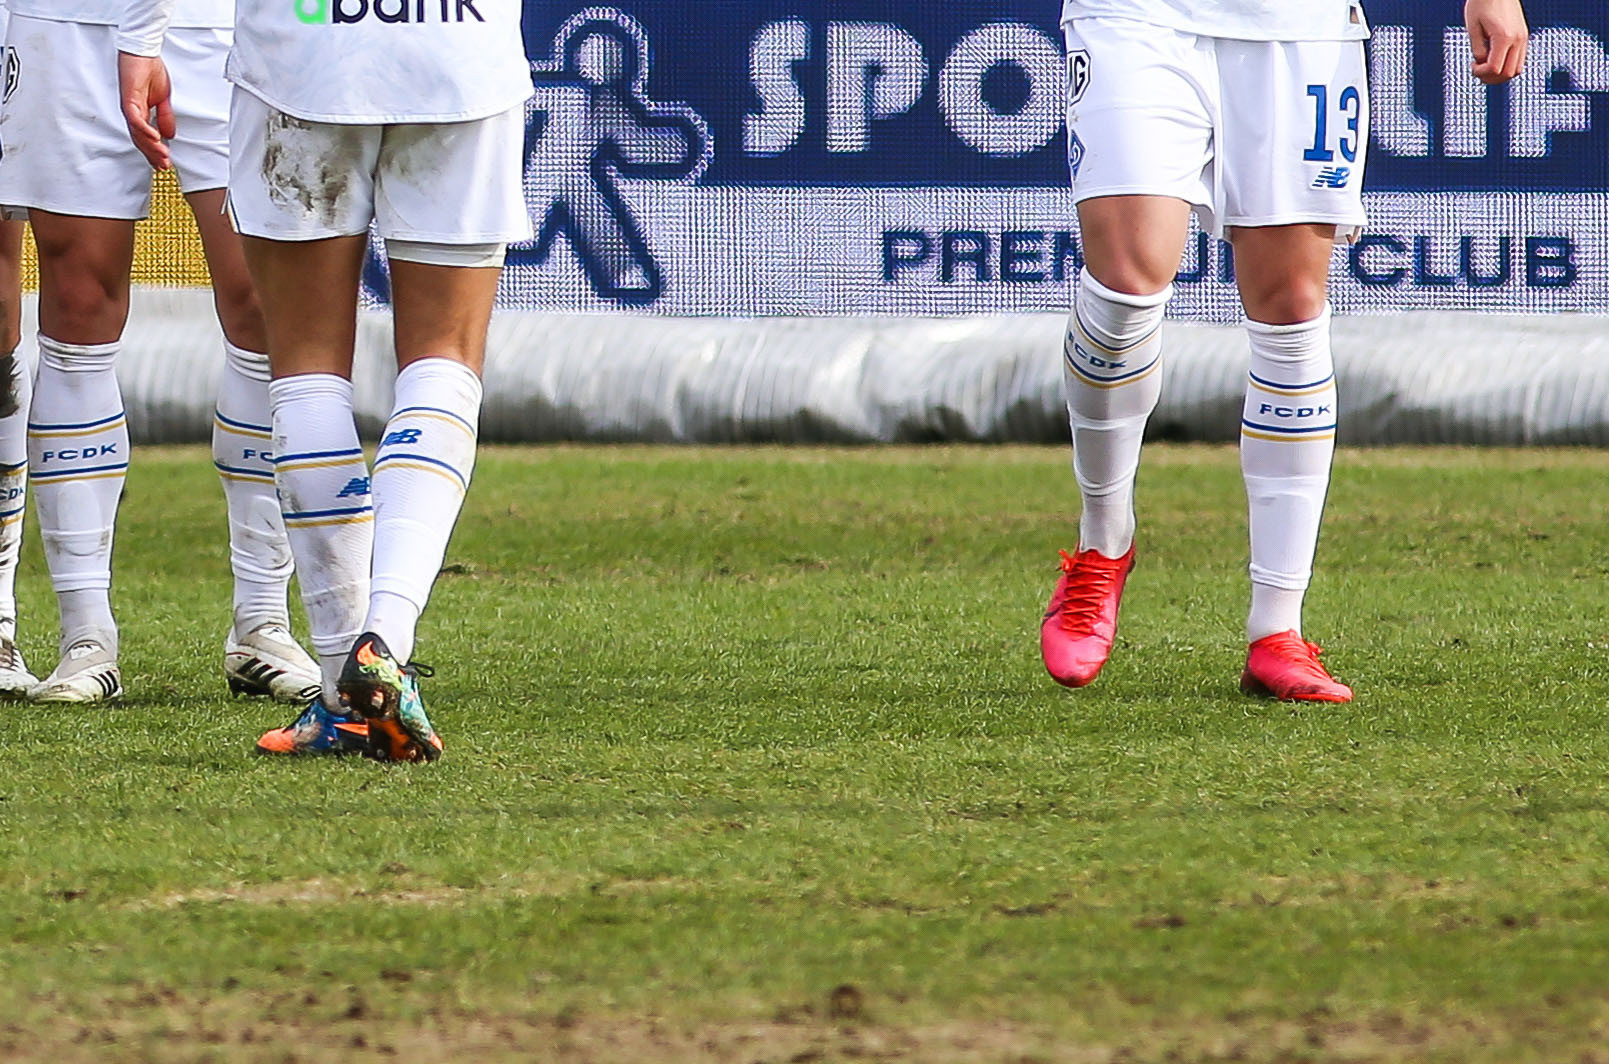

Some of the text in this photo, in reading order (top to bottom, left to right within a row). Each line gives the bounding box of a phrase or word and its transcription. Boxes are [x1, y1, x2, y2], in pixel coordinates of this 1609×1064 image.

[741, 17, 1066, 157] SPO
[1303, 84, 1360, 163] 13
[1349, 233, 1579, 288] CLUB
[1259, 403, 1332, 419] FCDK
[42, 443, 118, 463] FCDK
[243, 449, 274, 463] FC
